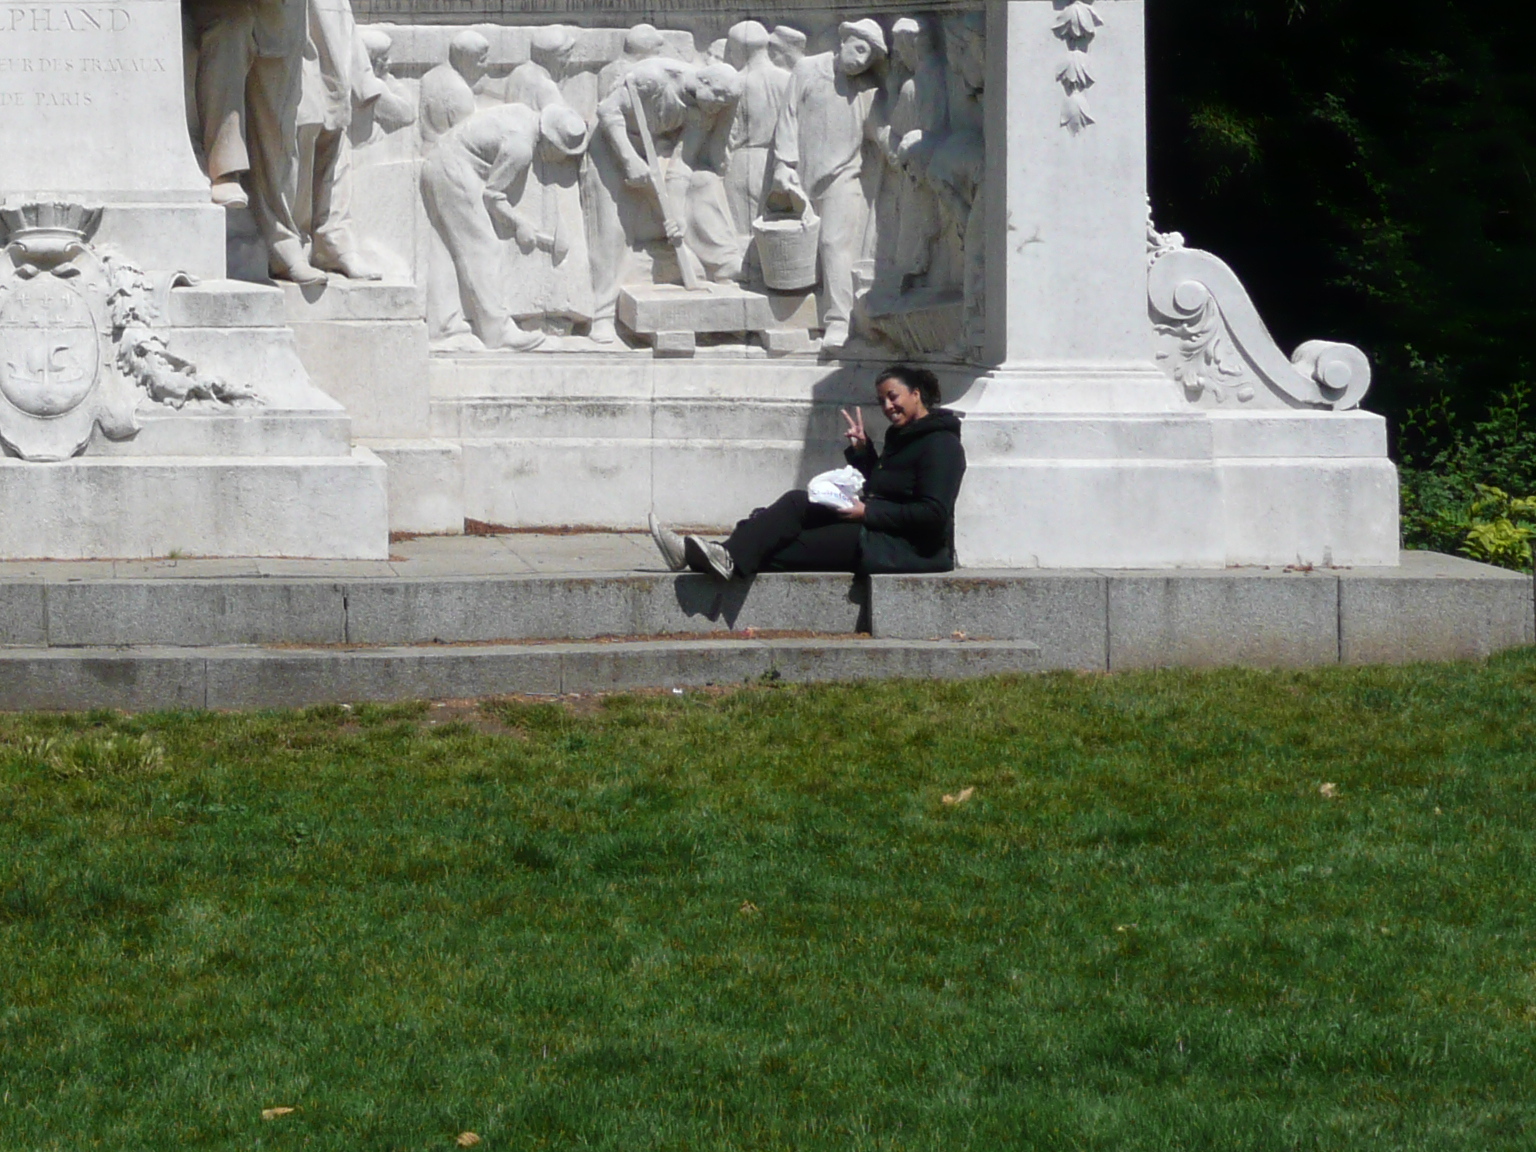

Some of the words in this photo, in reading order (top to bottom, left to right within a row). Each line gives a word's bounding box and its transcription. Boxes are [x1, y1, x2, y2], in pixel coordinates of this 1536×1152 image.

[38, 57, 74, 73] DES
[79, 57, 167, 73] TRAVAUX
[0, 91, 25, 106] DE
[35, 91, 93, 106] PARIS
